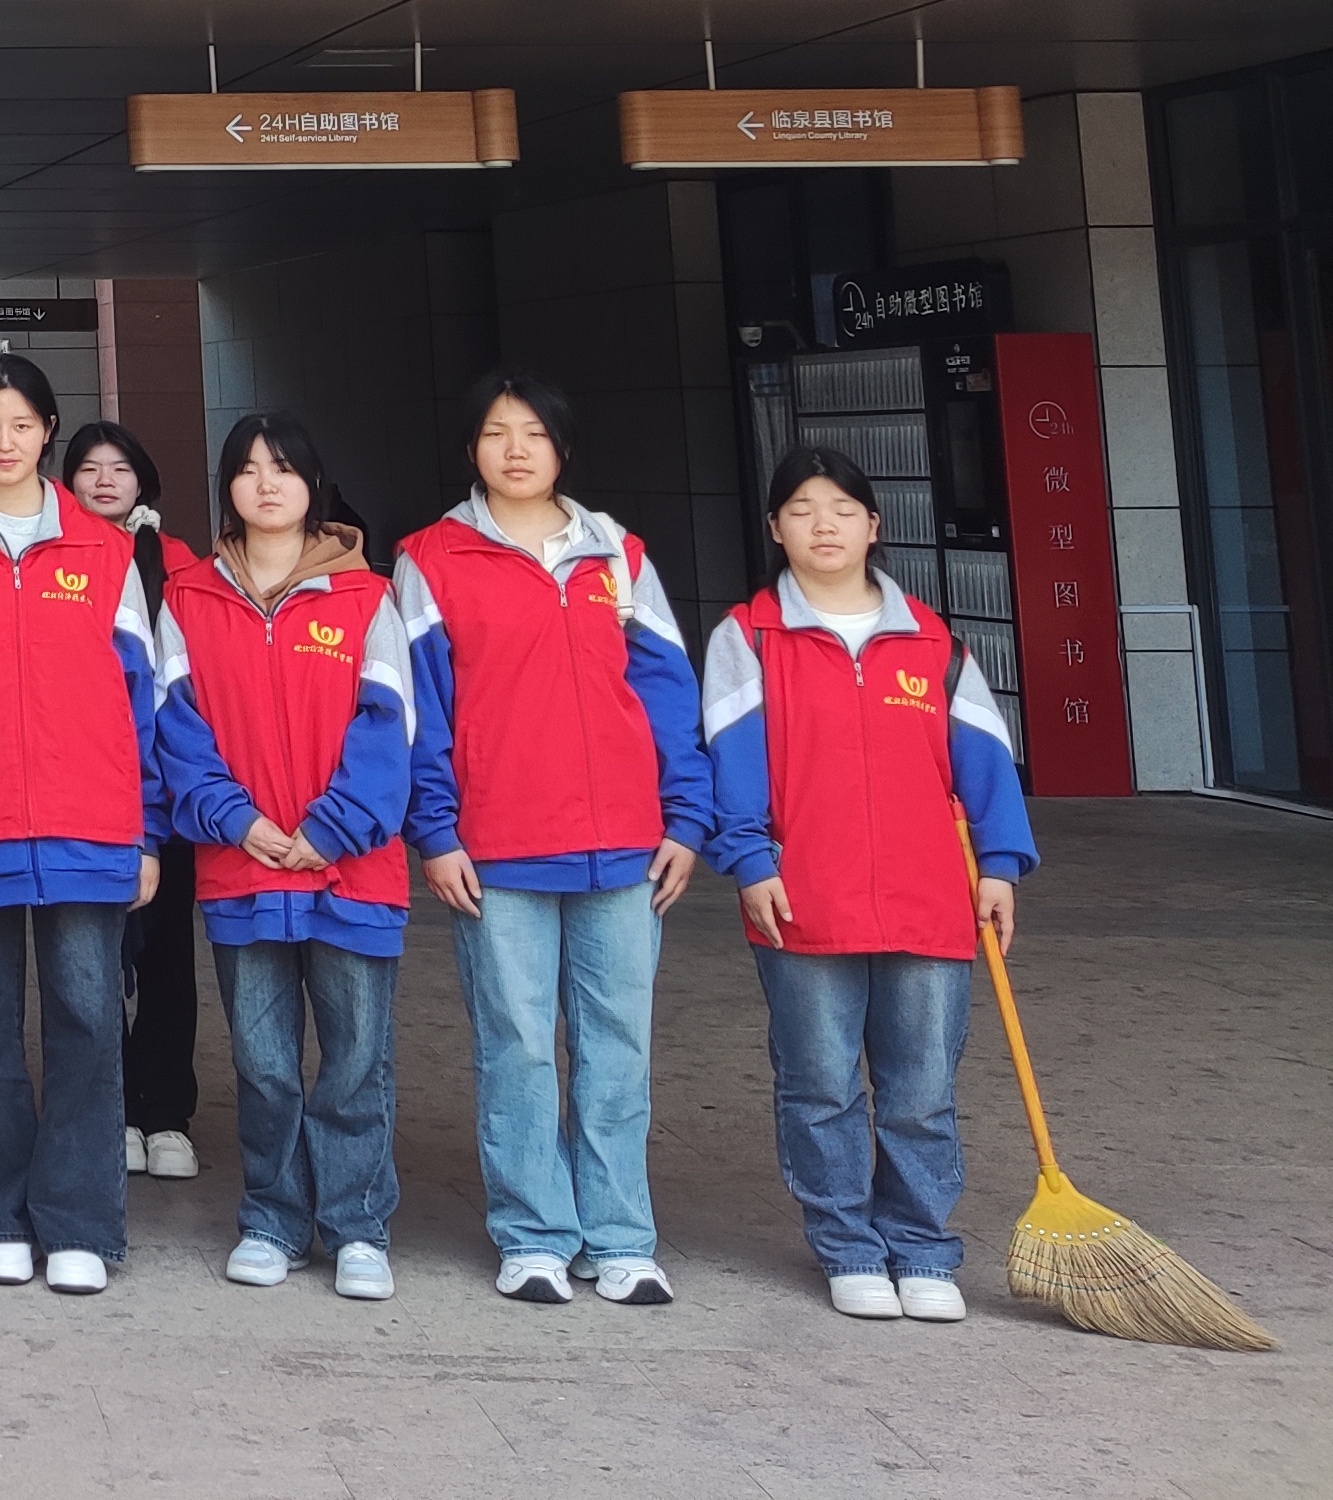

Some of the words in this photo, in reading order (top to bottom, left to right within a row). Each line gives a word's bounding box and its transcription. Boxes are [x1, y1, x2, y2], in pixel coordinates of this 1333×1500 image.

[259, 112, 400, 132] 24H自助图书馆
[771, 109, 893, 129] 临泉县图书馆
[260, 134, 278, 143] 24H
[279, 134, 327, 143] Self-service
[329, 134, 357, 144] Library
[773, 131, 807, 141] Linquan
[808, 132, 837, 141] County
[839, 132, 867, 141] Library
[875, 282, 984, 320] 自助微型图书馆
[855, 312, 874, 330] 24h
[1043, 466, 1090, 725] 微型图书馆
